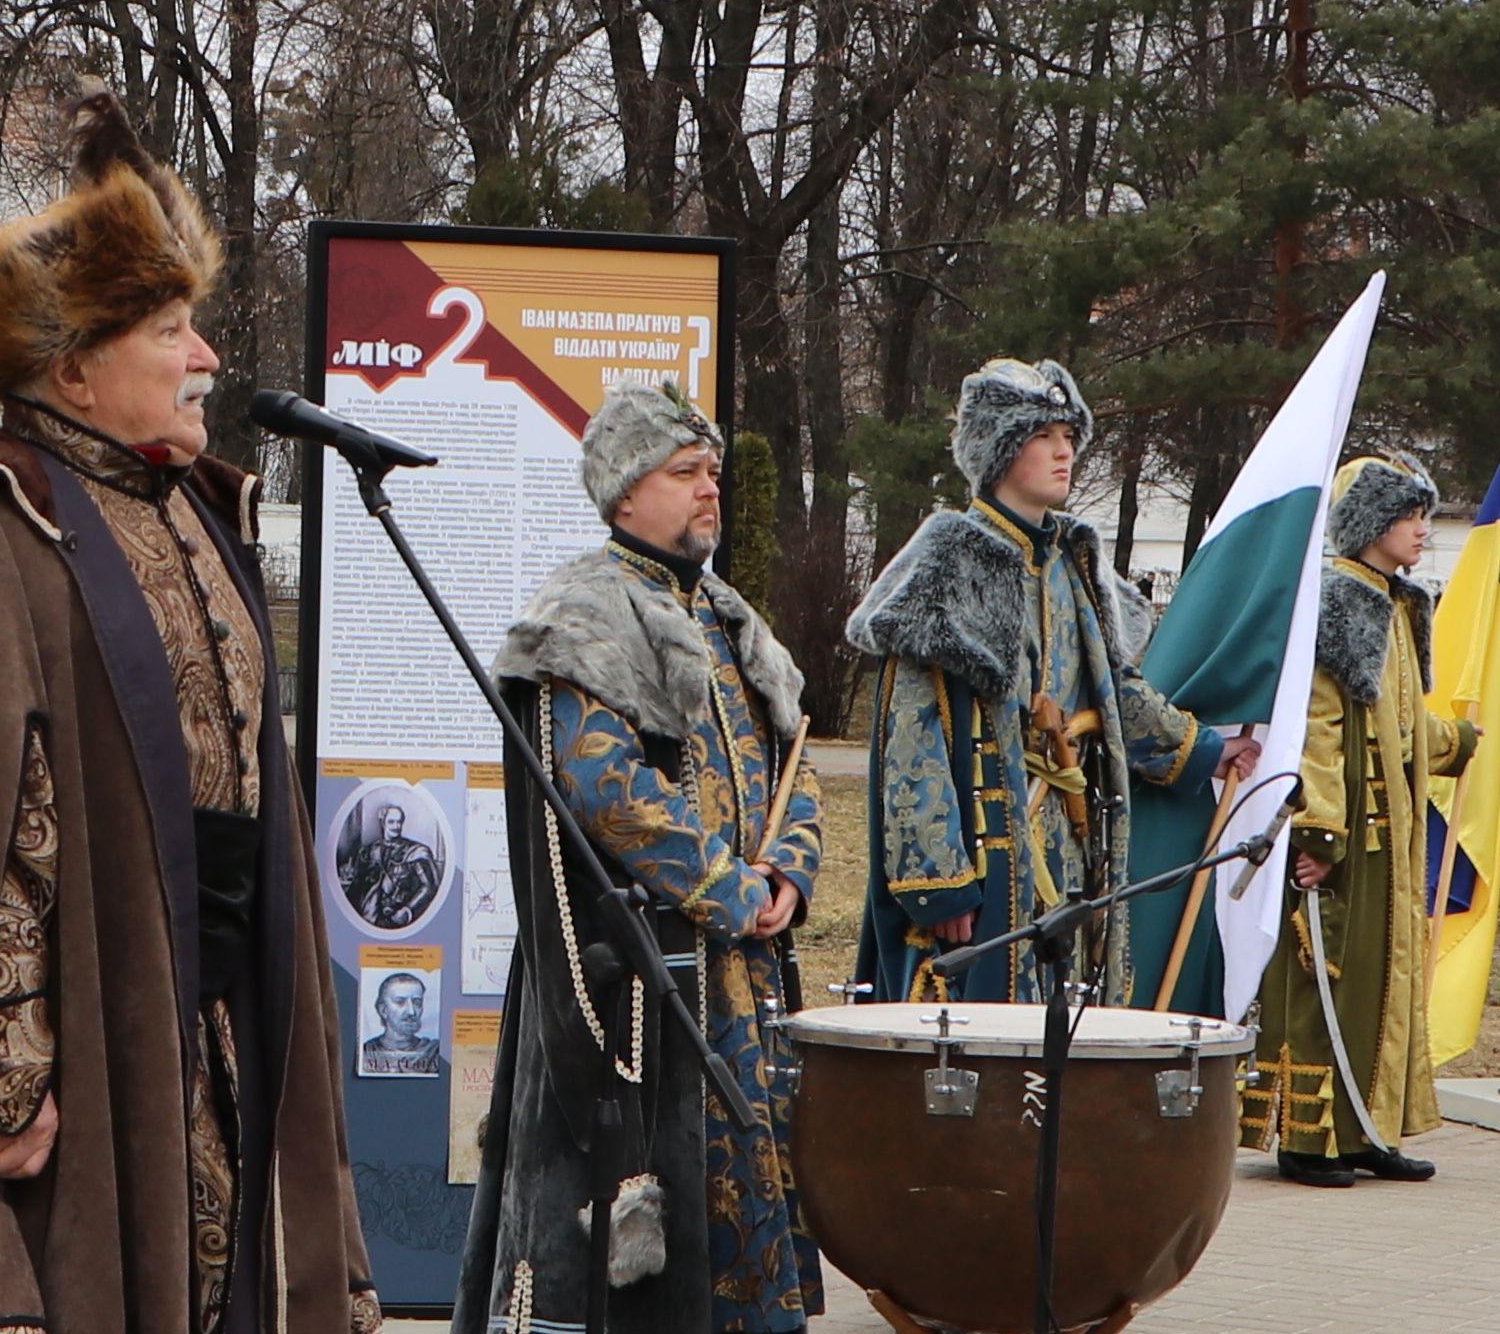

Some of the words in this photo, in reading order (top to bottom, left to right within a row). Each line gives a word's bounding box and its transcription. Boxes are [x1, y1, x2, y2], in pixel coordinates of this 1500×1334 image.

[426, 285, 487, 378] 2
[521, 308, 555, 328] ІВАН
[557, 310, 614, 330] МАЗЕПА
[615, 313, 681, 333] ПРАГНУВ
[553, 337, 616, 358] ВІДДАТИ
[618, 337, 680, 360] УКРАЇНУ
